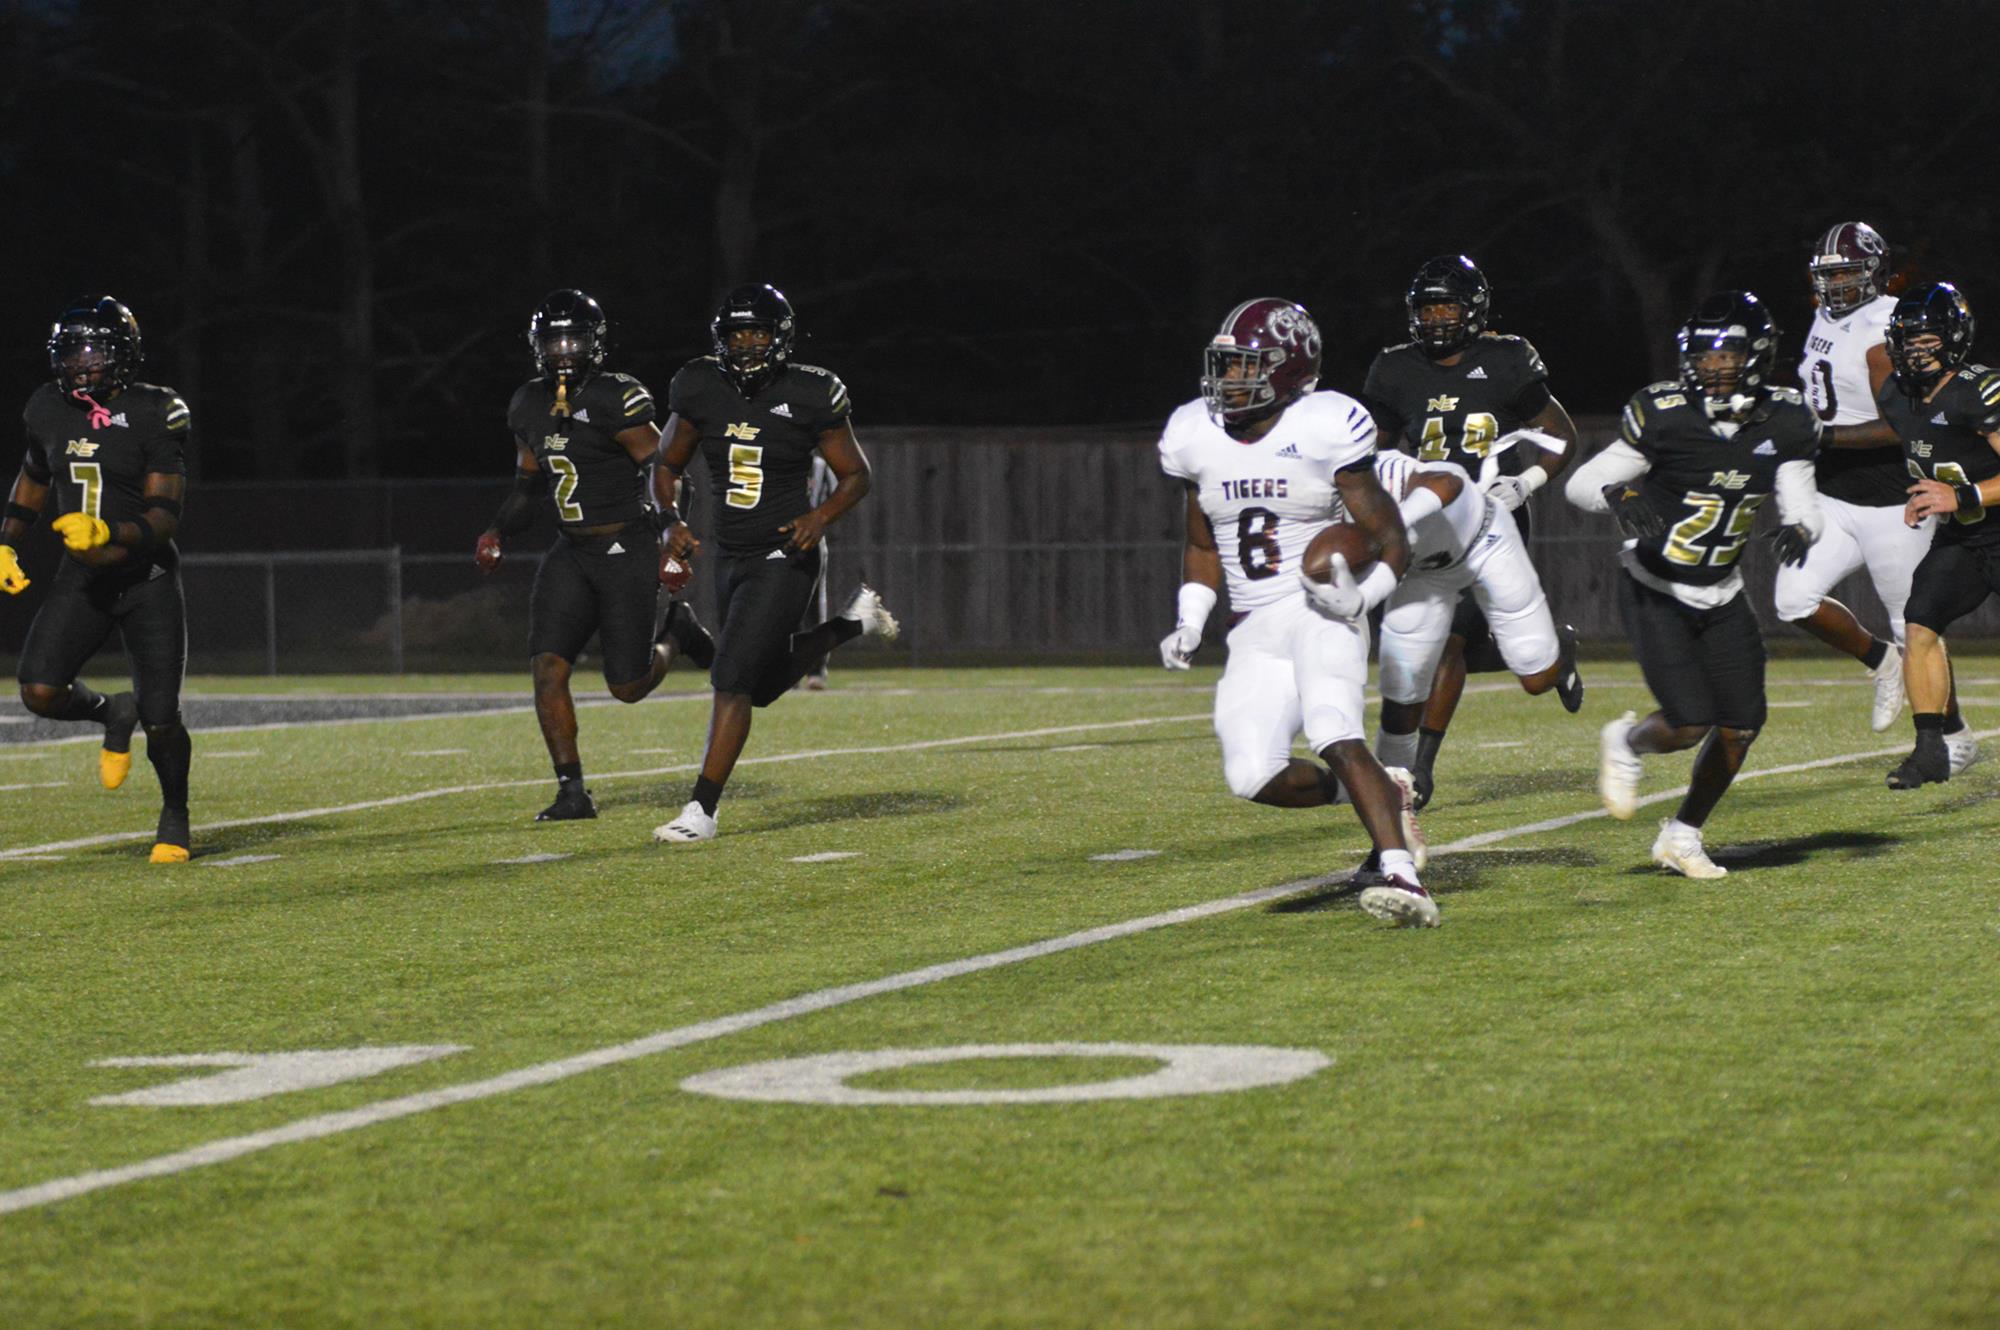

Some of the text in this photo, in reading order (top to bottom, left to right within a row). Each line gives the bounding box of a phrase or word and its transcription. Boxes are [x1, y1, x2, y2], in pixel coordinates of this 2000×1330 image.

[548, 455, 584, 521] 2
[725, 443, 764, 509] 5
[1222, 478, 1288, 501] TIGERS
[1237, 506, 1283, 582] 8
